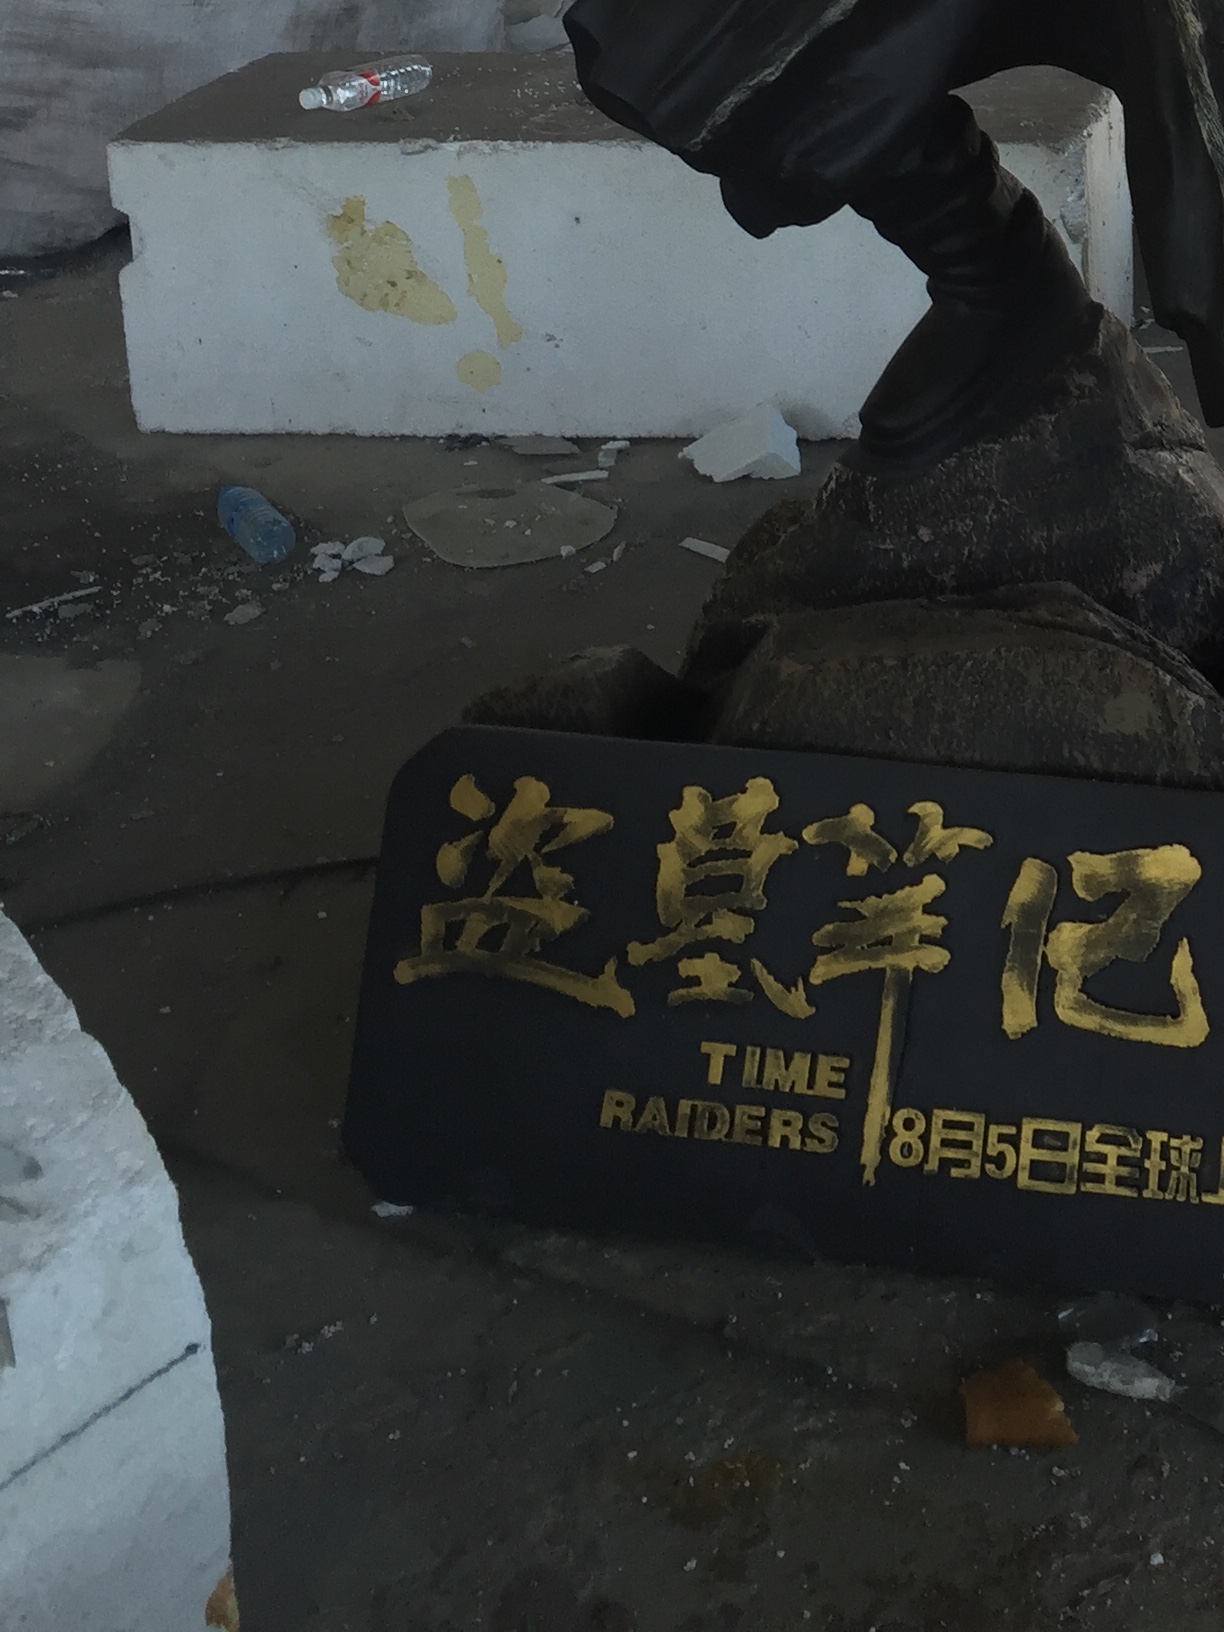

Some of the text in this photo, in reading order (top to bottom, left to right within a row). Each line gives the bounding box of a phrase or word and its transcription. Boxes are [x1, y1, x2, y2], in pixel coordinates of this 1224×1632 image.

[393, 775, 1210, 1187] 盗墓笔记
[700, 1040, 851, 1100] TIME
[599, 1088, 840, 1155] RAIDERS
